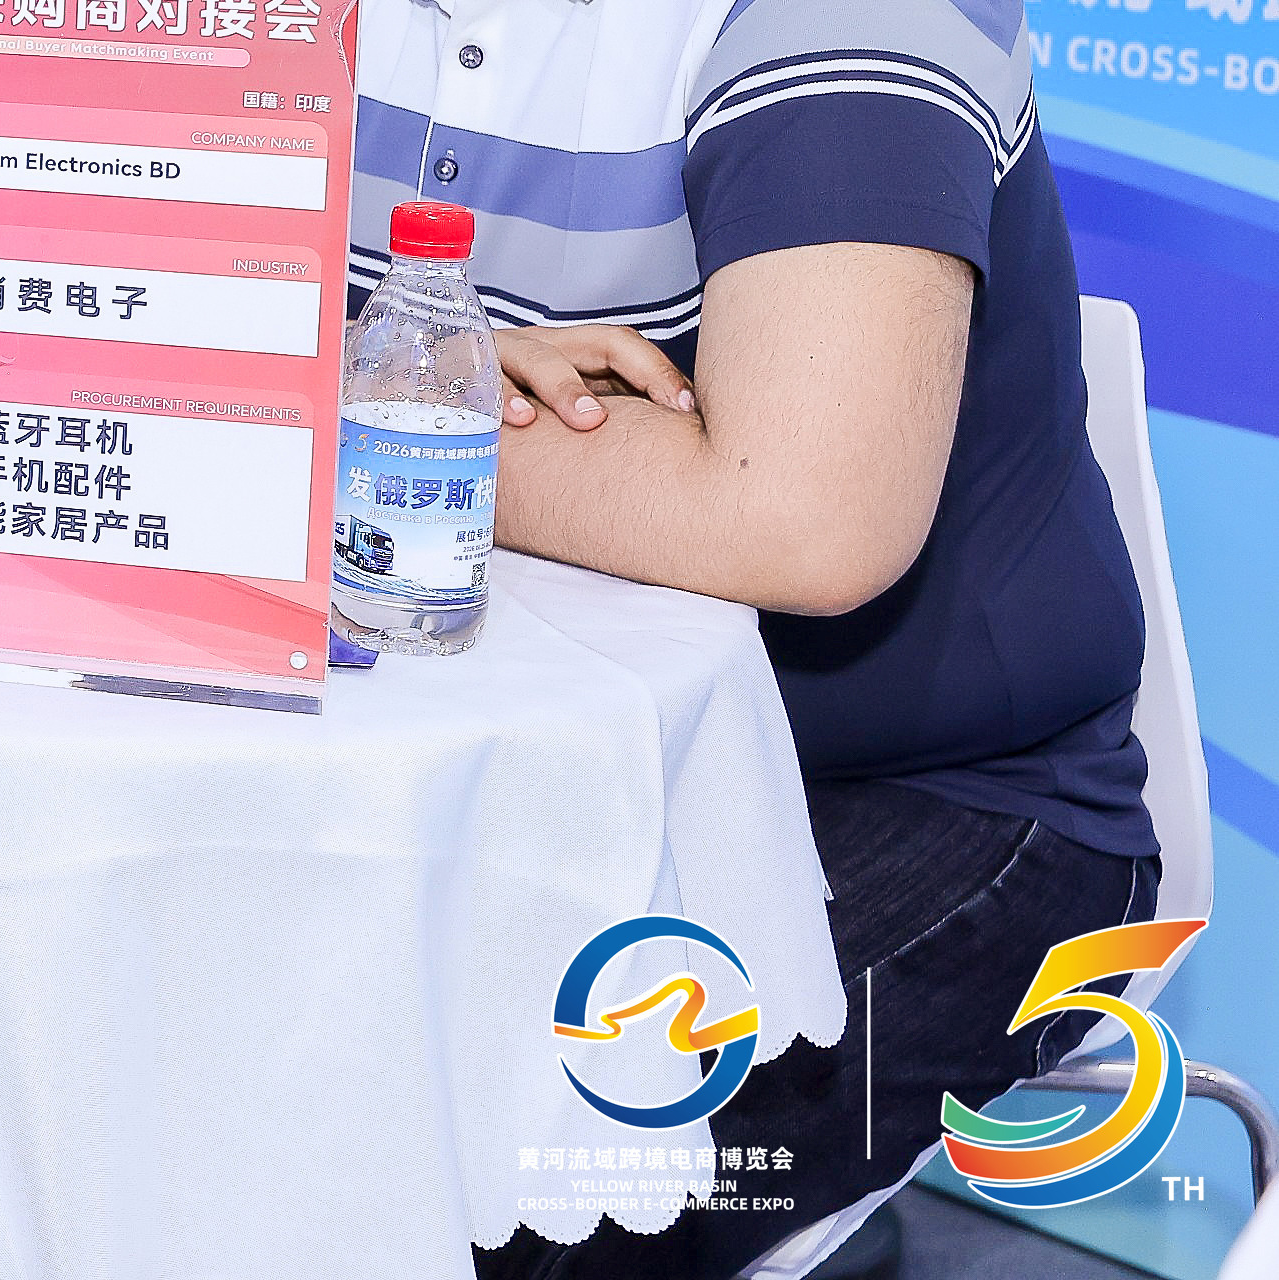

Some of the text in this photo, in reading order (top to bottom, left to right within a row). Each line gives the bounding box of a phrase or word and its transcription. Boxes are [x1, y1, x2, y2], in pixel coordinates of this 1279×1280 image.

[25, 39, 66, 54] Buyer
[70, 42, 169, 61] Matchmaking
[173, 48, 215, 62] Event
[191, 131, 315, 152] COMPANY NAME
[26, 152, 143, 177] Electronics
[150, 160, 181, 179] BD
[231, 258, 309, 277] INDUSTRY
[71, 389, 301, 422] PROCUREMENT REQUIREMENTS
[367, 506, 422, 524] Доставка
[425, 514, 432, 524] в
